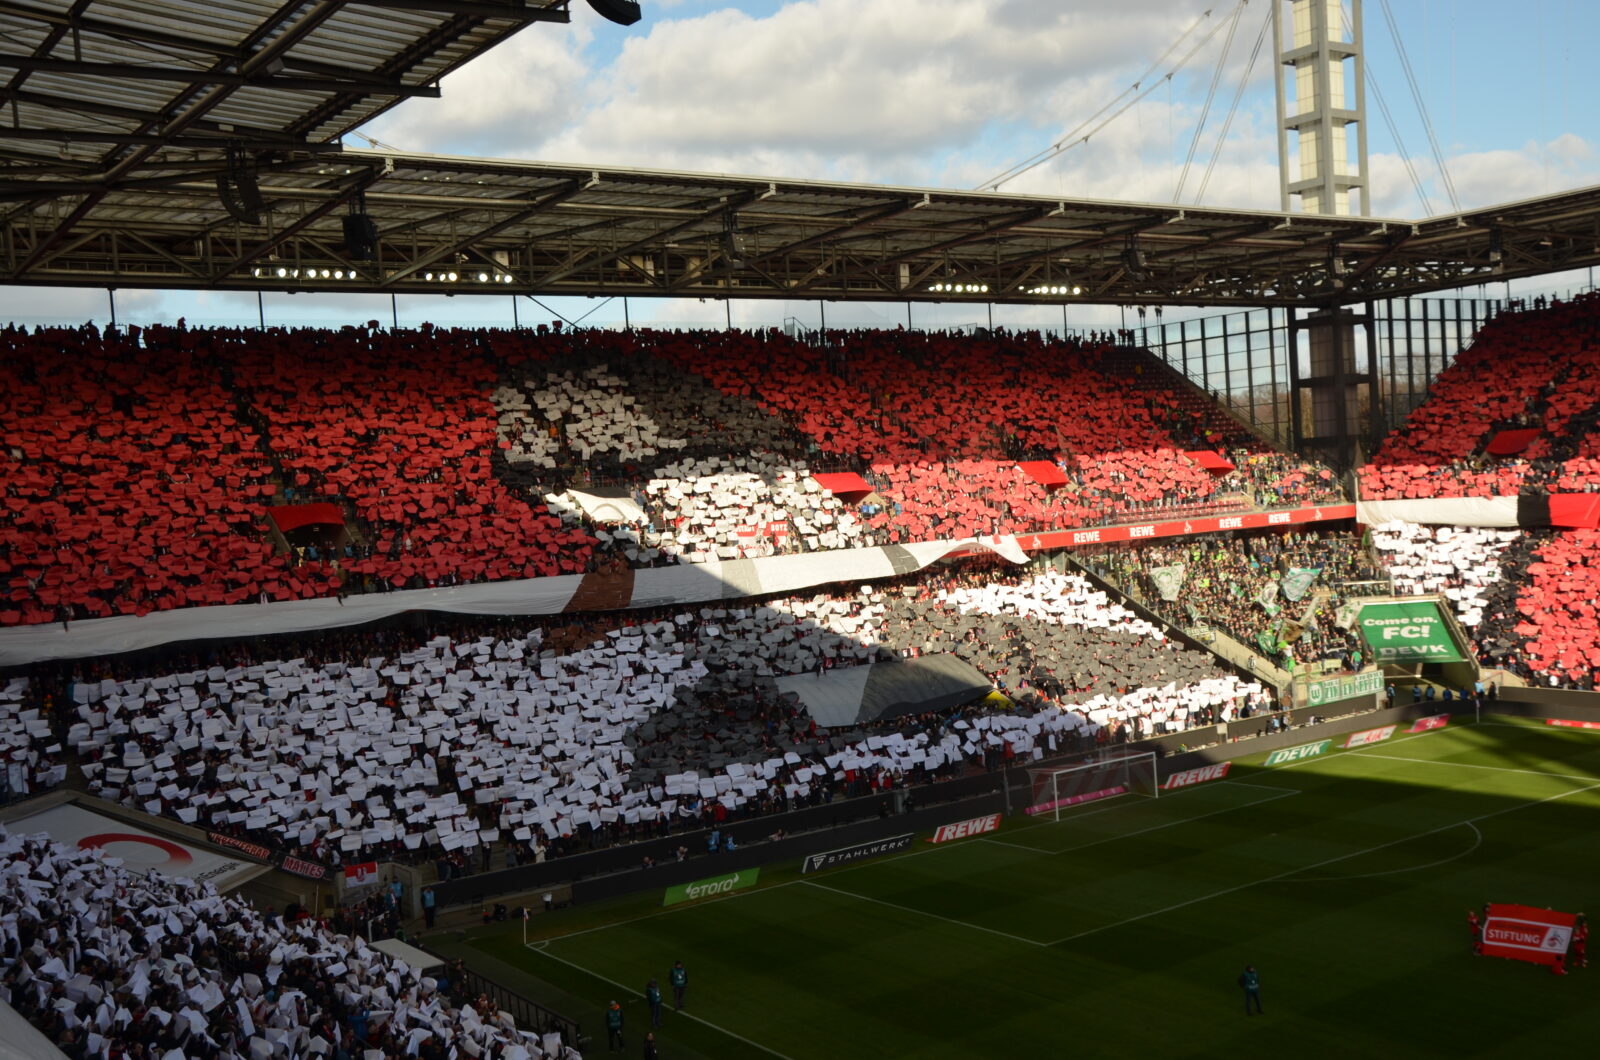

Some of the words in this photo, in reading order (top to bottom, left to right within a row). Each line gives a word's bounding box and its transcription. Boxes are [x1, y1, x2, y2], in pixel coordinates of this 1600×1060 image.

[1219, 517, 1243, 529] REWE
[1268, 513, 1291, 524] REWE
[1074, 531, 1100, 544] REWE
[1129, 525, 1155, 538] REWE
[1363, 617, 1410, 627] Come
[1383, 625, 1431, 640] FC!
[1379, 644, 1449, 657] DEVK
[1273, 742, 1325, 764] DEVK
[1173, 765, 1225, 787] REWE
[941, 815, 997, 841] REWE
[828, 839, 906, 863] STAHLWERK
[284, 857, 325, 878] MATTES
[1488, 929, 1541, 945] STIFTUNG
